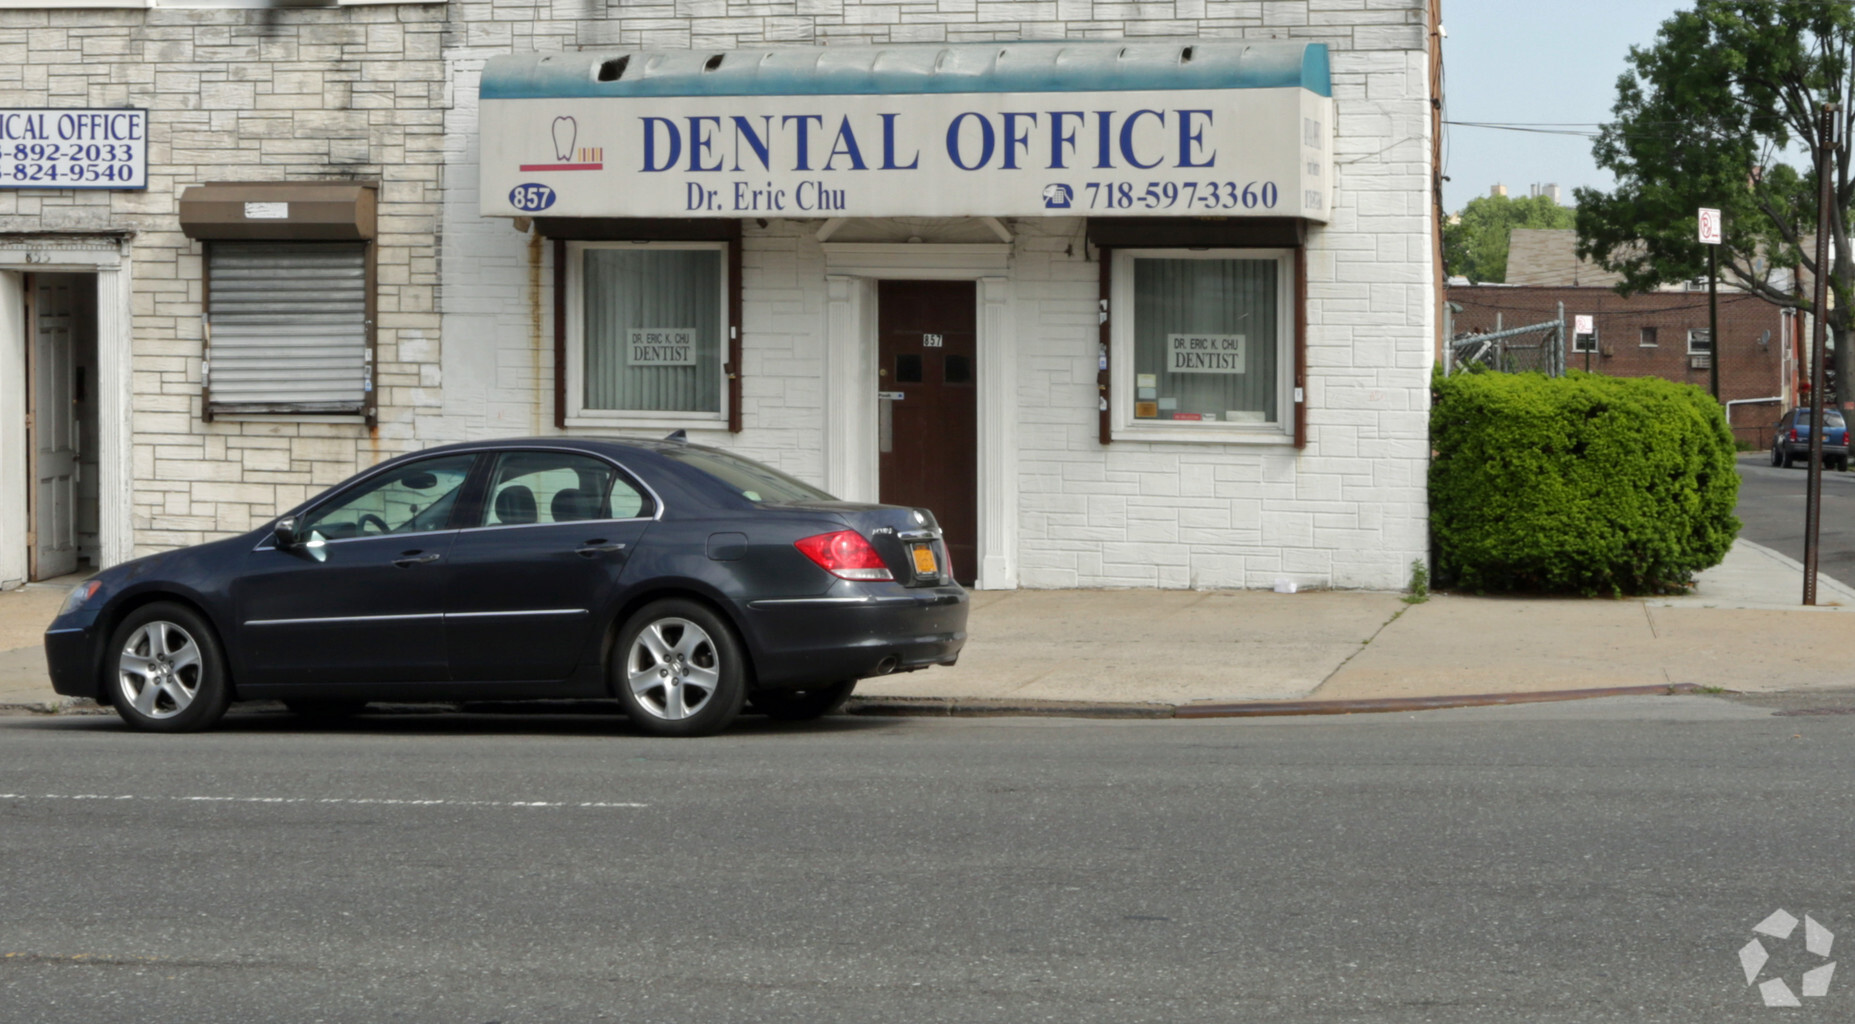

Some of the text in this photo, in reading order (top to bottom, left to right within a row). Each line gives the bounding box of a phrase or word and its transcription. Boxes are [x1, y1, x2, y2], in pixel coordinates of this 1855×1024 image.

[57, 113, 142, 141] OFFICE
[637, 109, 1217, 173] DENTAL OFFICE
[513, 186, 551, 209] 857
[686, 180, 846, 211] Dr. Eric Chu
[1085, 181, 1278, 209] 718-597-3360
[646, 333, 662, 344] ERIC
[675, 333, 690, 344] CHU
[924, 334, 941, 346] 857
[1174, 338, 1187, 349] DR.
[1190, 338, 1208, 350] ERIC
[1221, 339, 1238, 351] CHU
[633, 346, 690, 361] DENTIST
[1175, 352, 1239, 369] DENTIST
